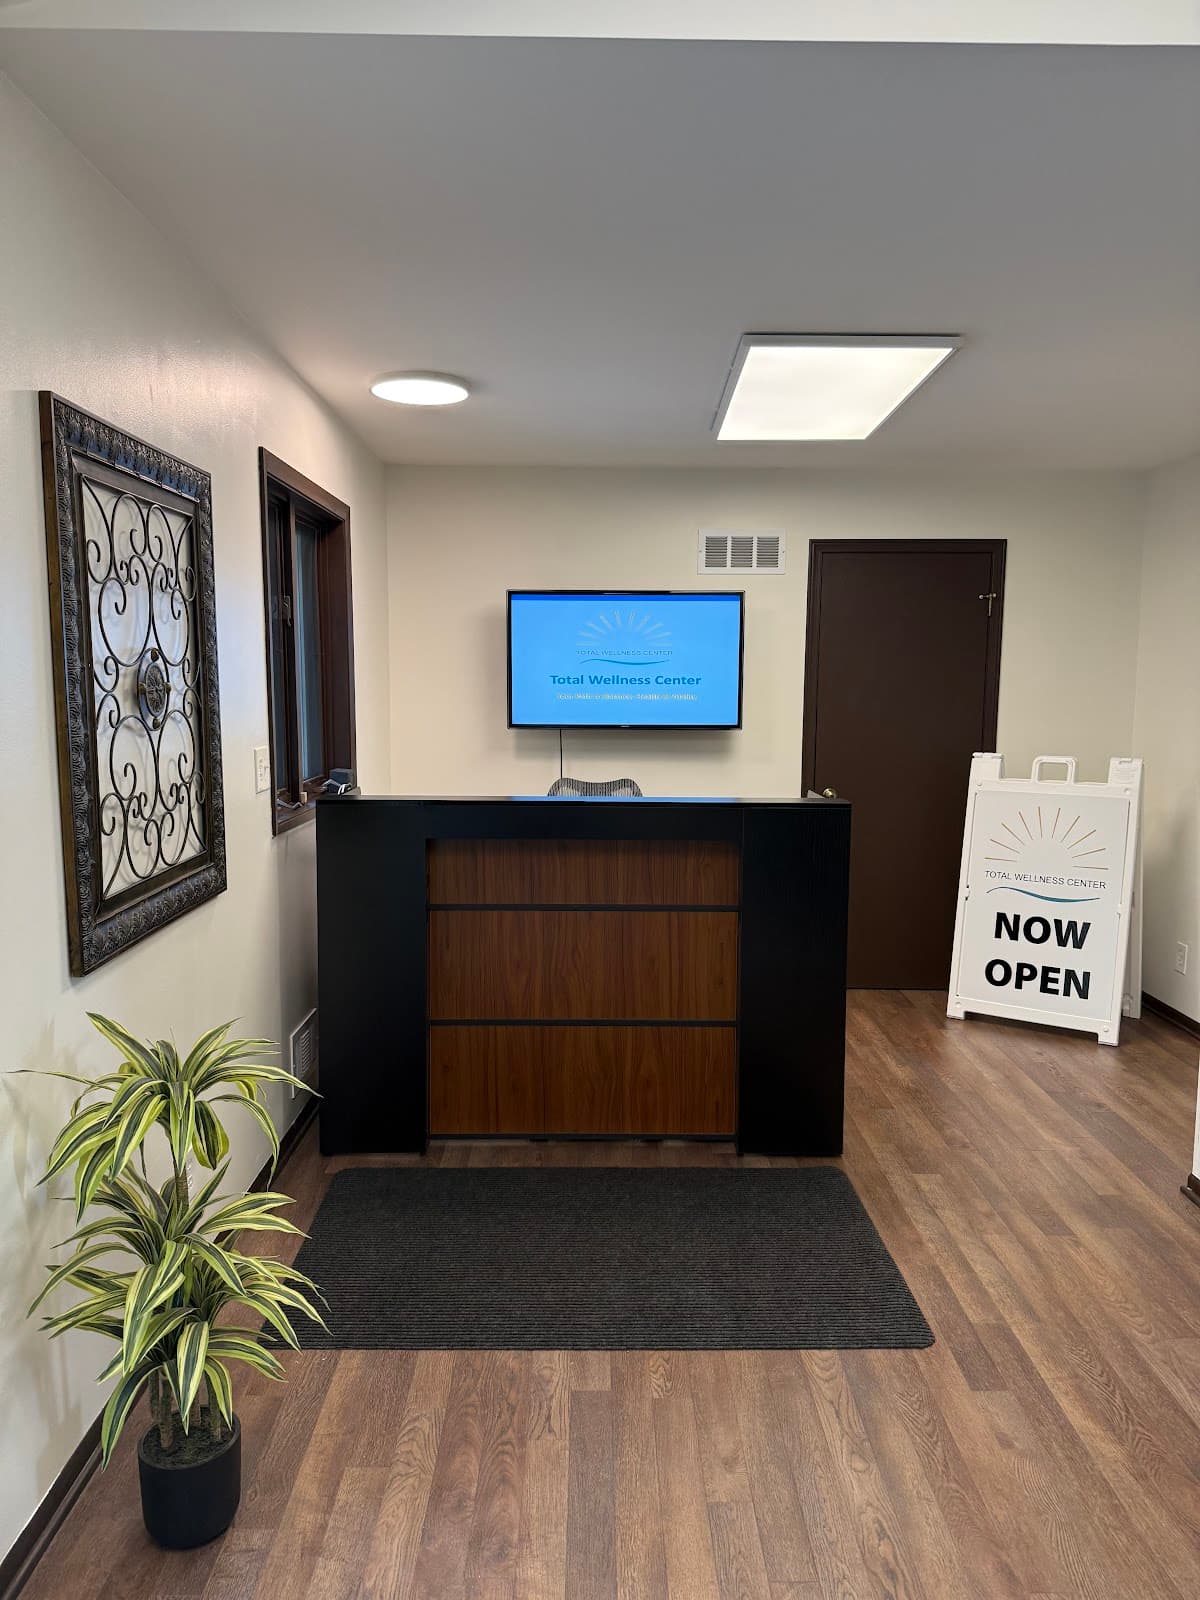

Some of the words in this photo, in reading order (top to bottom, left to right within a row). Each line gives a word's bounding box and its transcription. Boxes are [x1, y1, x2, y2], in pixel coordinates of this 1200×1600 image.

[550, 675, 584, 685] Total
[588, 675, 651, 685] Wellness
[655, 675, 702, 685] Center
[984, 870, 1012, 881] TOTAL
[1014, 872, 1065, 885] WELLNESS
[1066, 878, 1107, 889] CENTER
[994, 911, 1091, 950] NOW
[984, 958, 1091, 1000] OPEN
